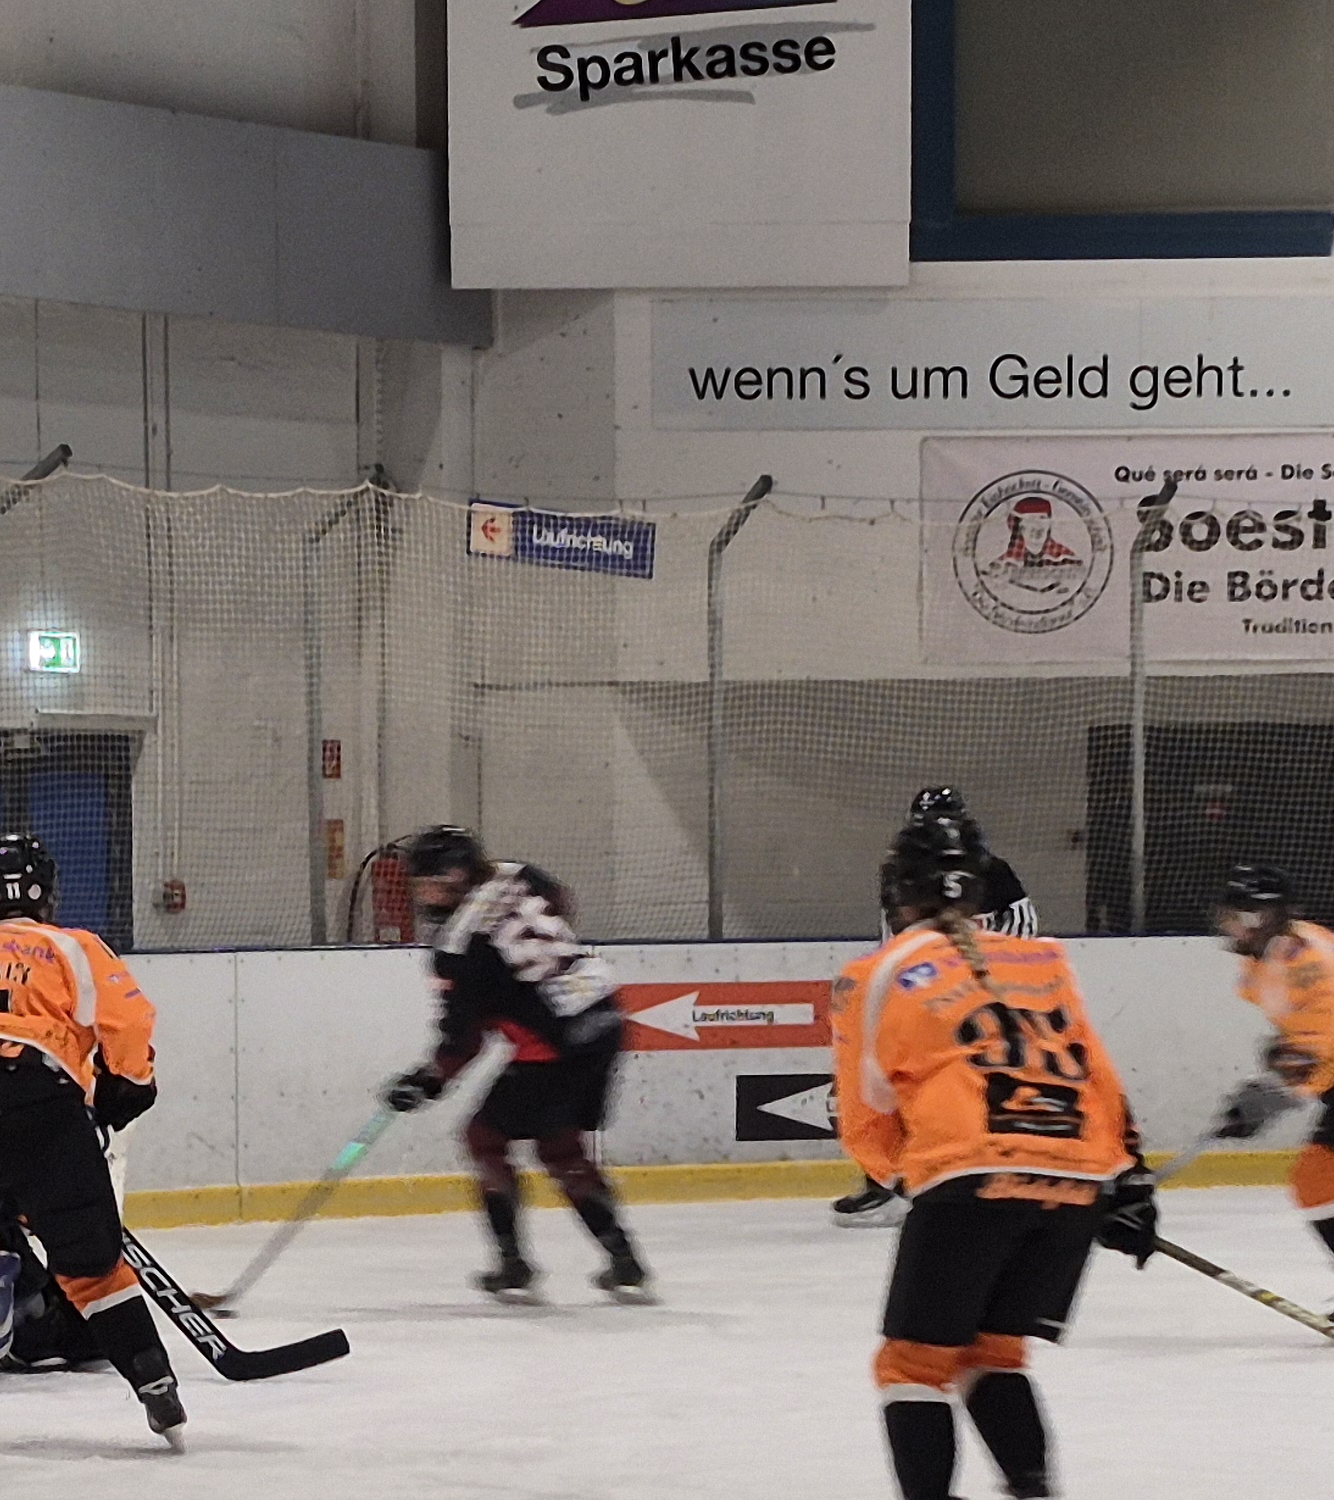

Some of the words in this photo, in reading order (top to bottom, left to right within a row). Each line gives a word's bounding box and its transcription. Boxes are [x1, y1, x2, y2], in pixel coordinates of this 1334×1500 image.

[536, 36, 836, 102] Sparkasse
[890, 366, 968, 401] um
[988, 353, 1110, 400] Geld
[1128, 355, 1292, 411] geht...
[1114, 465, 1157, 484] Qué
[1163, 464, 1208, 483] será
[1214, 464, 1259, 482] será
[1280, 463, 1315, 481] Die
[1141, 570, 1211, 604] Die
[1242, 617, 1334, 635] Tradition
[692, 1008, 775, 1025] Laufrichtung
